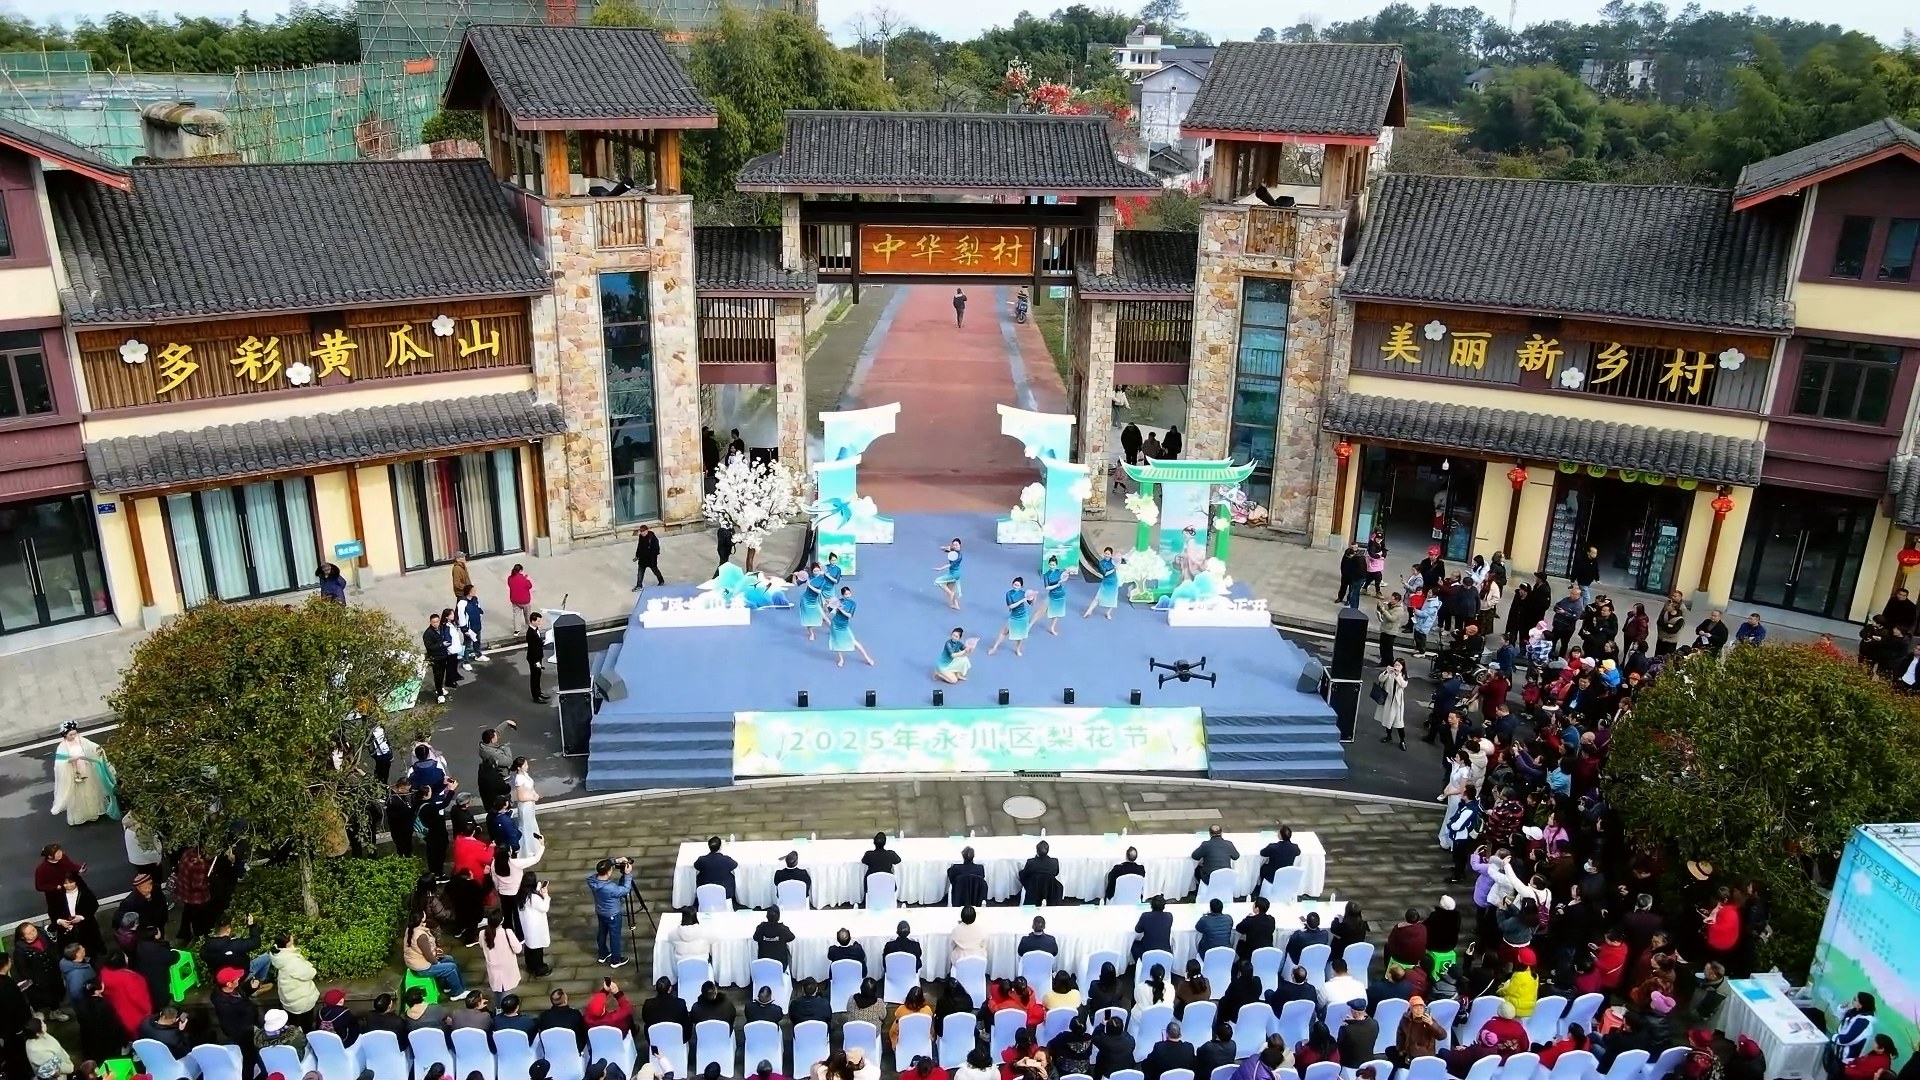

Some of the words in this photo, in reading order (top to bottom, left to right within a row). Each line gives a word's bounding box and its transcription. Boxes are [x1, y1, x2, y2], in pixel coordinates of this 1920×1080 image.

[872, 233, 1023, 267] 中华梨村
[156, 319, 500, 394] 多彩黄瓜山
[1380, 322, 1715, 395] 美丽新乡村
[790, 727, 1148, 752] 2025年永川区梨花节
